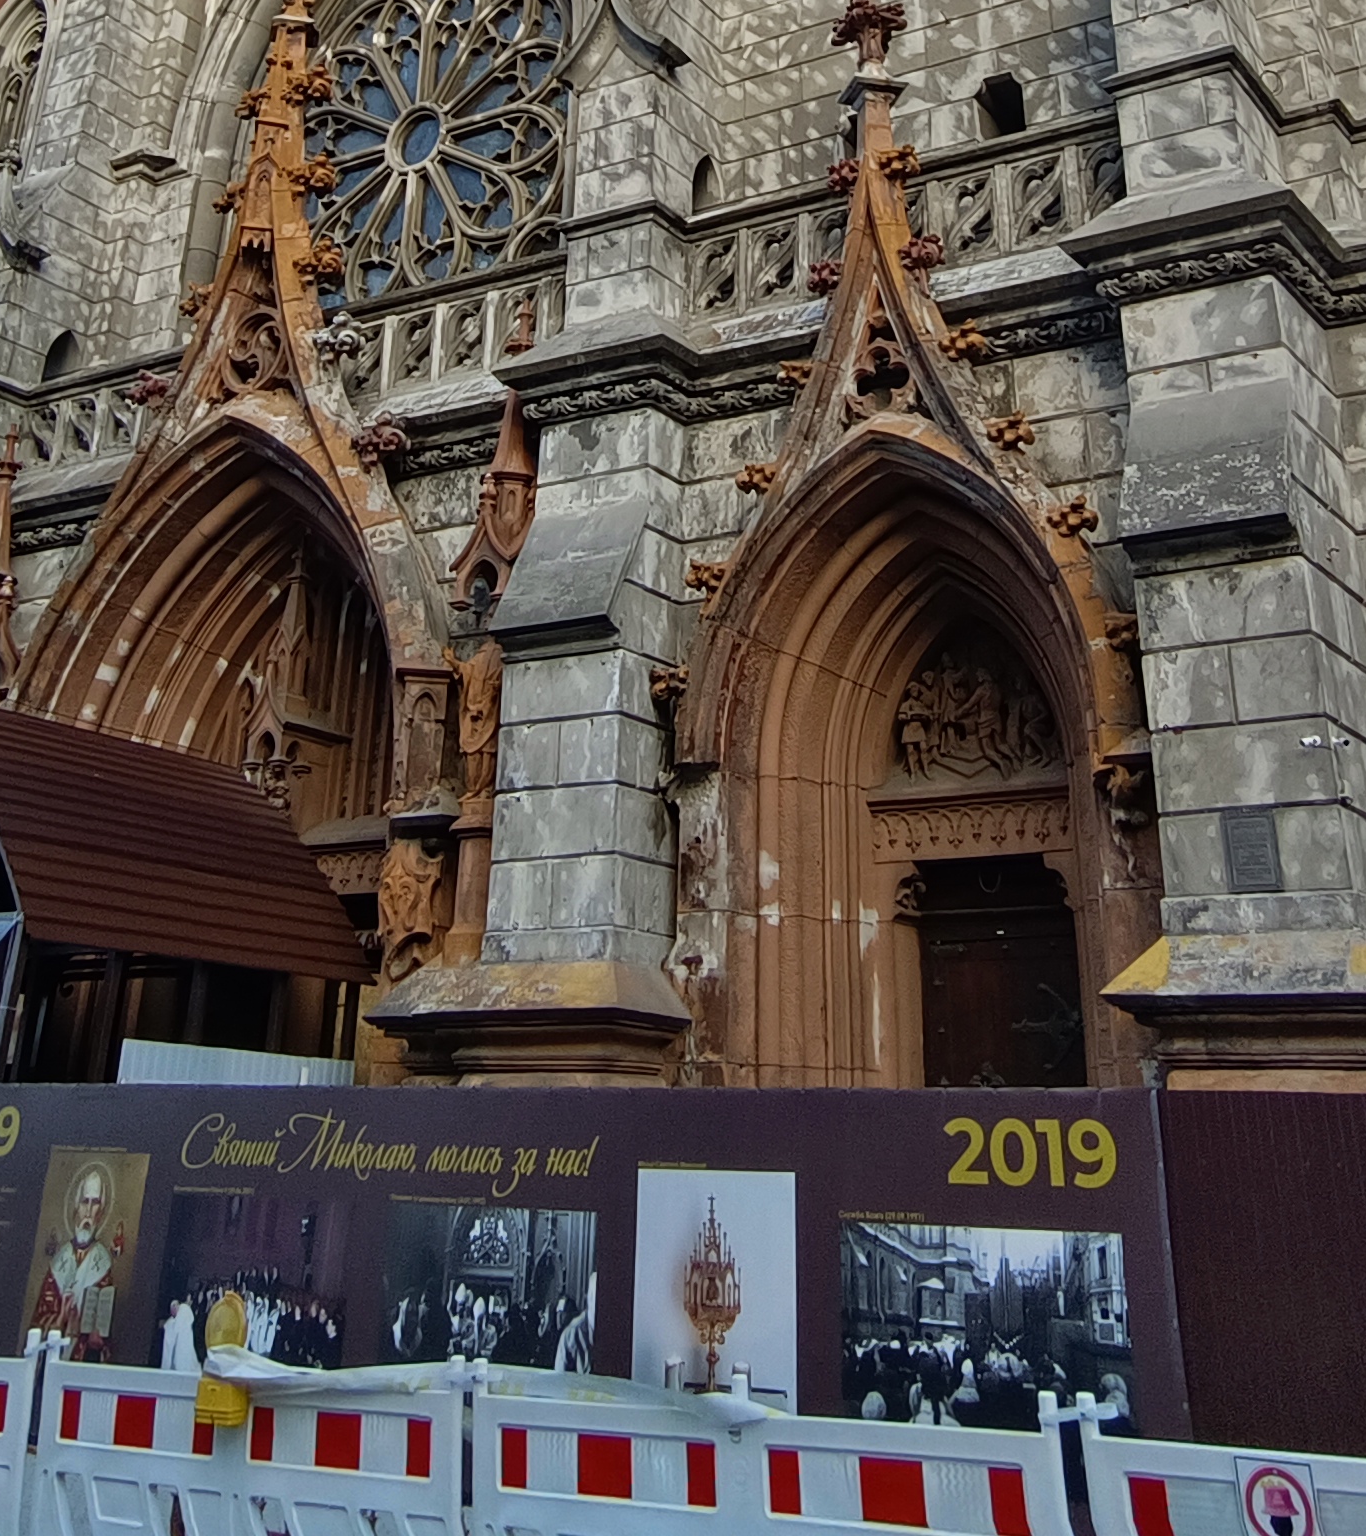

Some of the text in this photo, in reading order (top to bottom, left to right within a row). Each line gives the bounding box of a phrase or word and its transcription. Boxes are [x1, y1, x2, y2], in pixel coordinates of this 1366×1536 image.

[181, 1108, 600, 1197] Святий Миколаю, молись за нас!
[942, 1117, 1117, 1189] 2019
